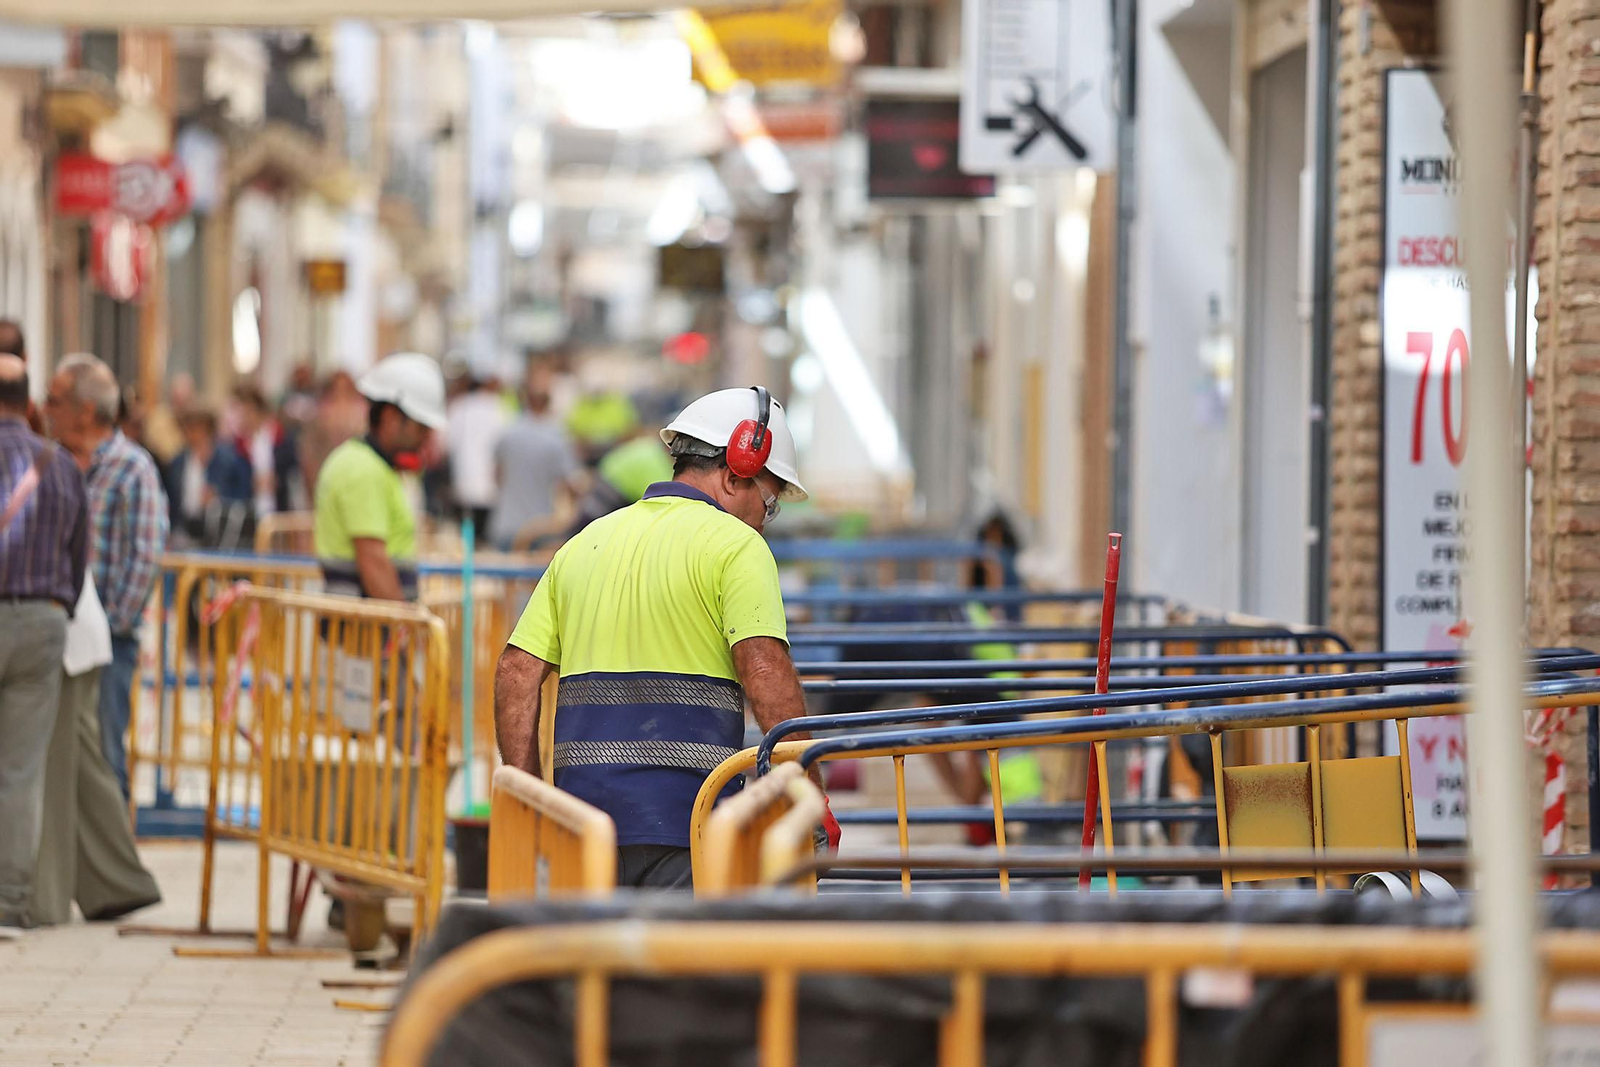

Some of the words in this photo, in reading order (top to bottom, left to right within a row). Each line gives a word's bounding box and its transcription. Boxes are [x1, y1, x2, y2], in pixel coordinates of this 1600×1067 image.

[1405, 326, 1471, 467] 70
[1422, 517, 1474, 538] MEJO
[1394, 595, 1462, 616] COMPL
